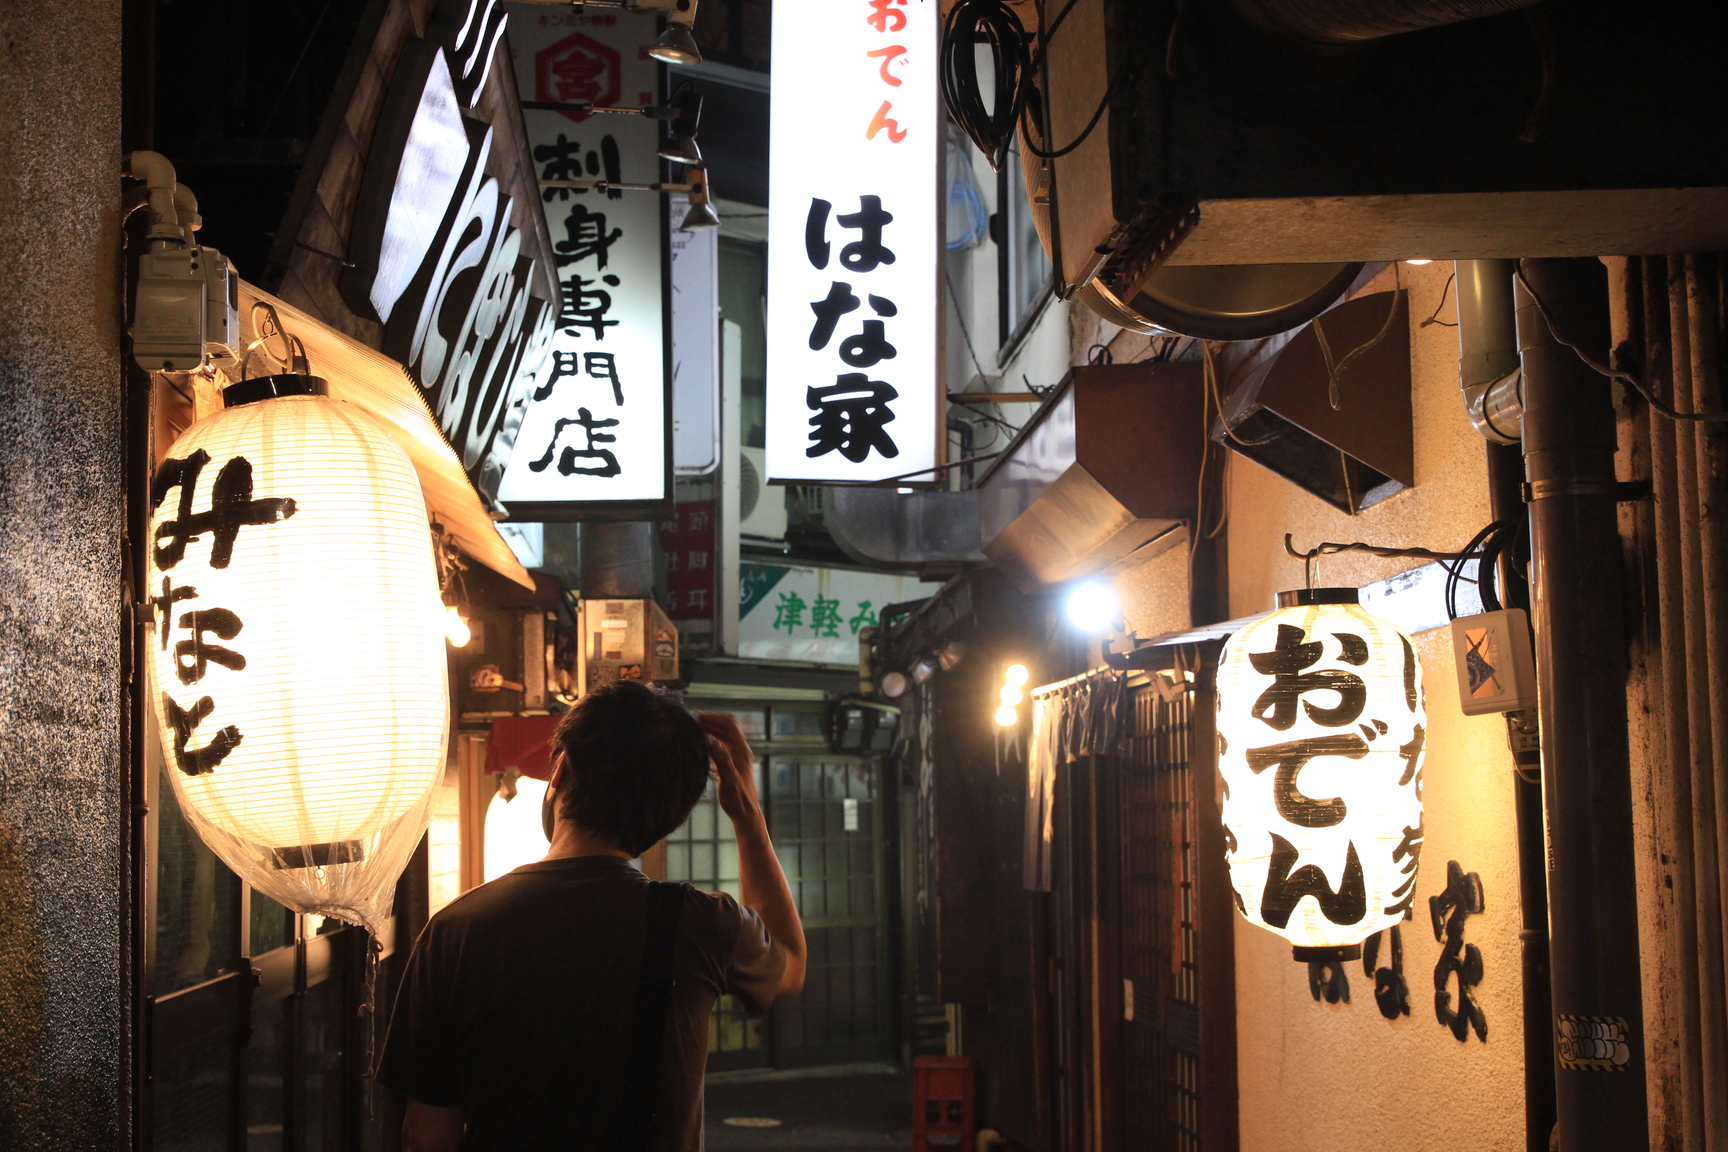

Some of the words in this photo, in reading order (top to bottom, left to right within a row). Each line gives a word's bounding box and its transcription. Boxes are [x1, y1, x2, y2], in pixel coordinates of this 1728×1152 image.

[865, 0, 909, 143] おでん
[528, 133, 627, 478] 刺身専門店
[805, 194, 899, 463] はな家
[772, 591, 911, 639] 津軽み
[1246, 623, 1389, 930] おでん
